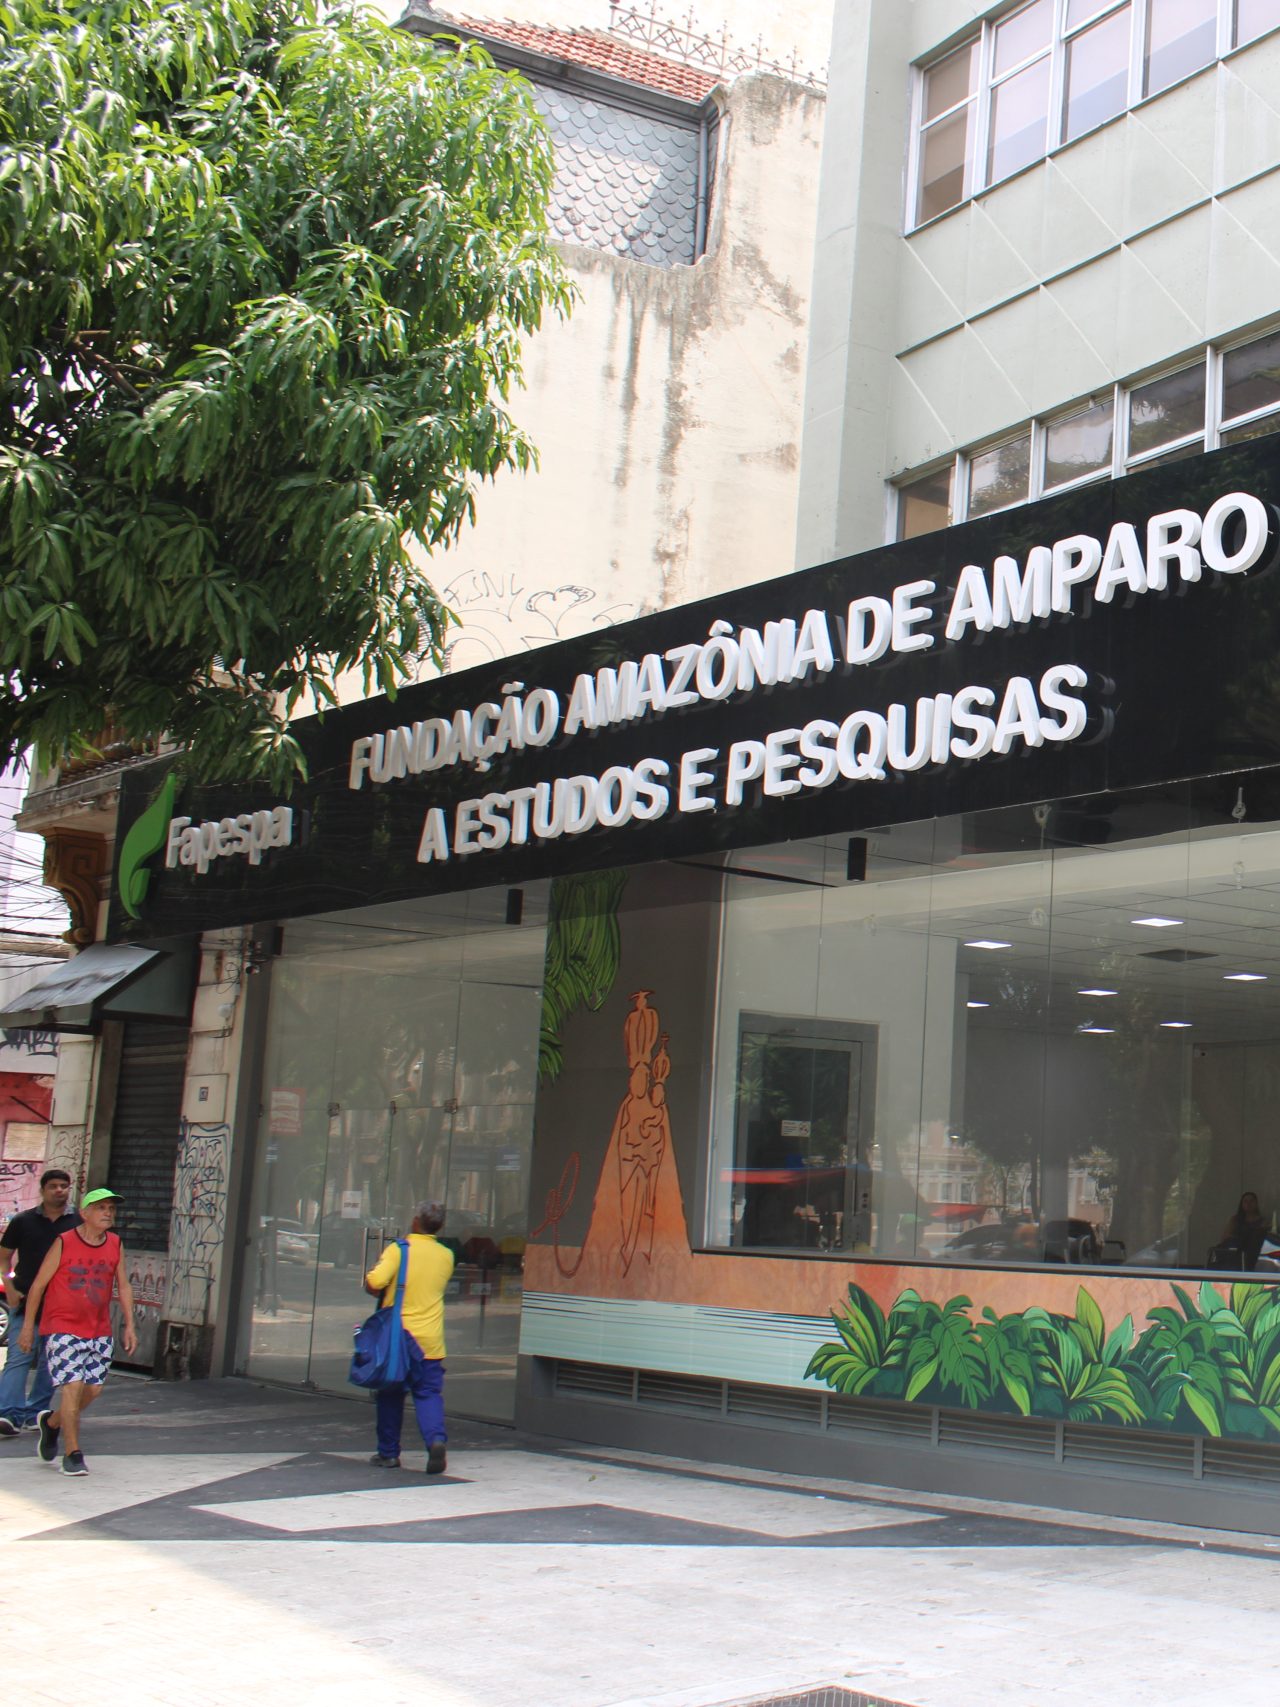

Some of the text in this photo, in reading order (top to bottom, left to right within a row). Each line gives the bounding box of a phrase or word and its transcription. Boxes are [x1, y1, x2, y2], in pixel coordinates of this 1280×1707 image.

[349, 492, 1268, 791] FUNDAÇÃO AMAZÔNIA DE AMPARO
[165, 806, 293, 874] Fapespa
[417, 664, 1088, 863] A ESTUDOS E PESQUISAS
